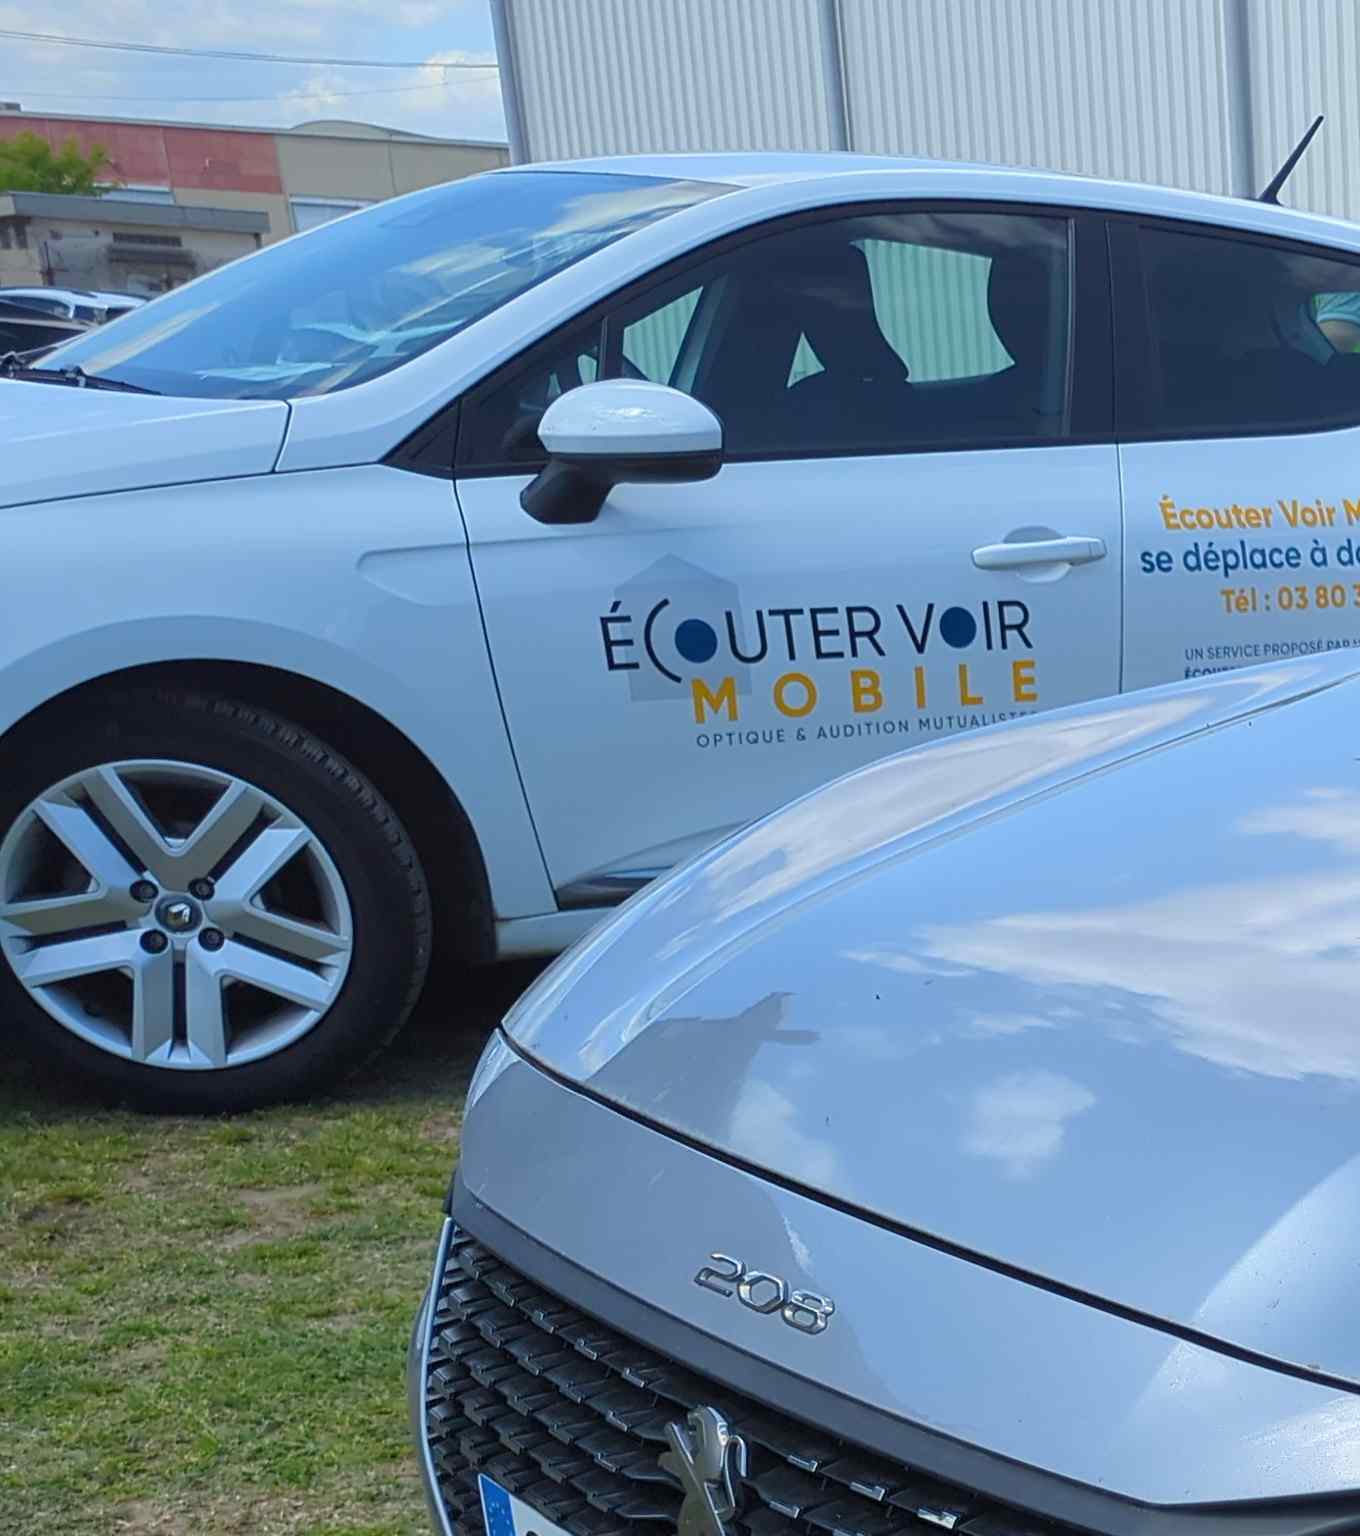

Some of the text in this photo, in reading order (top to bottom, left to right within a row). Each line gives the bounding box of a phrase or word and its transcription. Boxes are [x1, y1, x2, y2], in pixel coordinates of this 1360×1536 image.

[1159, 495, 1272, 529] Écouter
[1277, 500, 1336, 528] Voir
[1140, 550, 1174, 574] se
[1183, 540, 1301, 578] déplace
[1310, 540, 1328, 567] à
[1220, 587, 1258, 613] Tél
[1278, 586, 1308, 610] 03
[1315, 585, 1345, 608] 80
[896, 600, 1034, 655] VOIR
[1184, 648, 1204, 661] UN
[1207, 643, 1260, 660] SERVICE
[1263, 636, 1323, 657] PROPOSÉ
[691, 660, 1038, 723] MOBILE
[696, 729, 785, 748] OPTIQUE
[795, 728, 807, 742] &
[816, 719, 910, 740] AUDITION
[694, 1253, 835, 1335] 208
